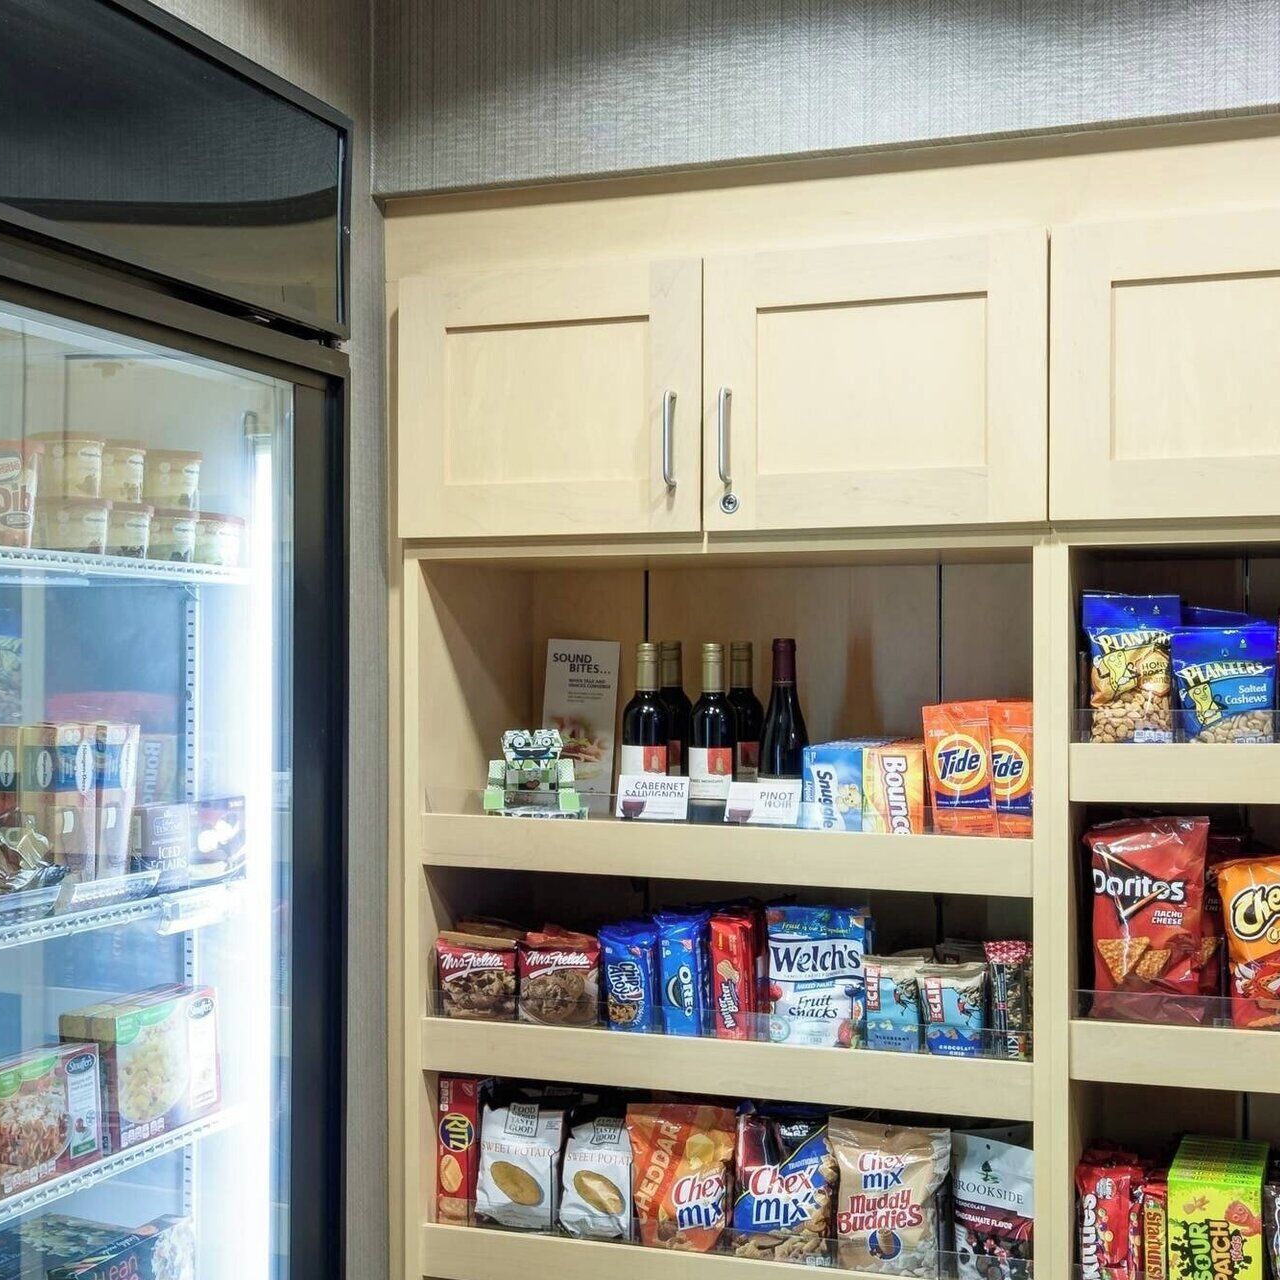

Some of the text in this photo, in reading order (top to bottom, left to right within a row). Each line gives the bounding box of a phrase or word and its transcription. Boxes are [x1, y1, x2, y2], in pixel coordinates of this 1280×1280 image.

[553, 652, 592, 664] SOUND
[1184, 662, 1264, 681] PLANTERS
[1239, 684, 1267, 694] Salted
[1225, 693, 1267, 705] Cashews
[937, 749, 981, 780] Tide
[634, 781, 686, 792] CABERNET
[759, 792, 795, 802] PINOT
[816, 770, 833, 829] Snuggle
[1093, 868, 1184, 901] Doritos
[1151, 916, 1183, 925] CHEESE
[1154, 910, 1183, 919] NACHO
[770, 945, 860, 973] Welch's
[679, 966, 693, 1017] OREO
[799, 995, 832, 1009] Fruit
[788, 1006, 838, 1019] Snacks
[509, 1124, 534, 1135] GOOD
[511, 1117, 534, 1126] TASTE
[449, 1115, 468, 1149] RITZ
[567, 1152, 594, 1162] SWEET
[859, 1152, 907, 1173] Chex
[634, 1121, 681, 1224] CHEDDAR
[750, 1166, 814, 1194] Chex
[674, 1172, 726, 1206] Chex
[850, 1188, 912, 1214] Muddy
[838, 1205, 922, 1233] Buddies
[993, 1219, 1013, 1229] FLAVOR
[1146, 1210, 1163, 1280] Starburst
